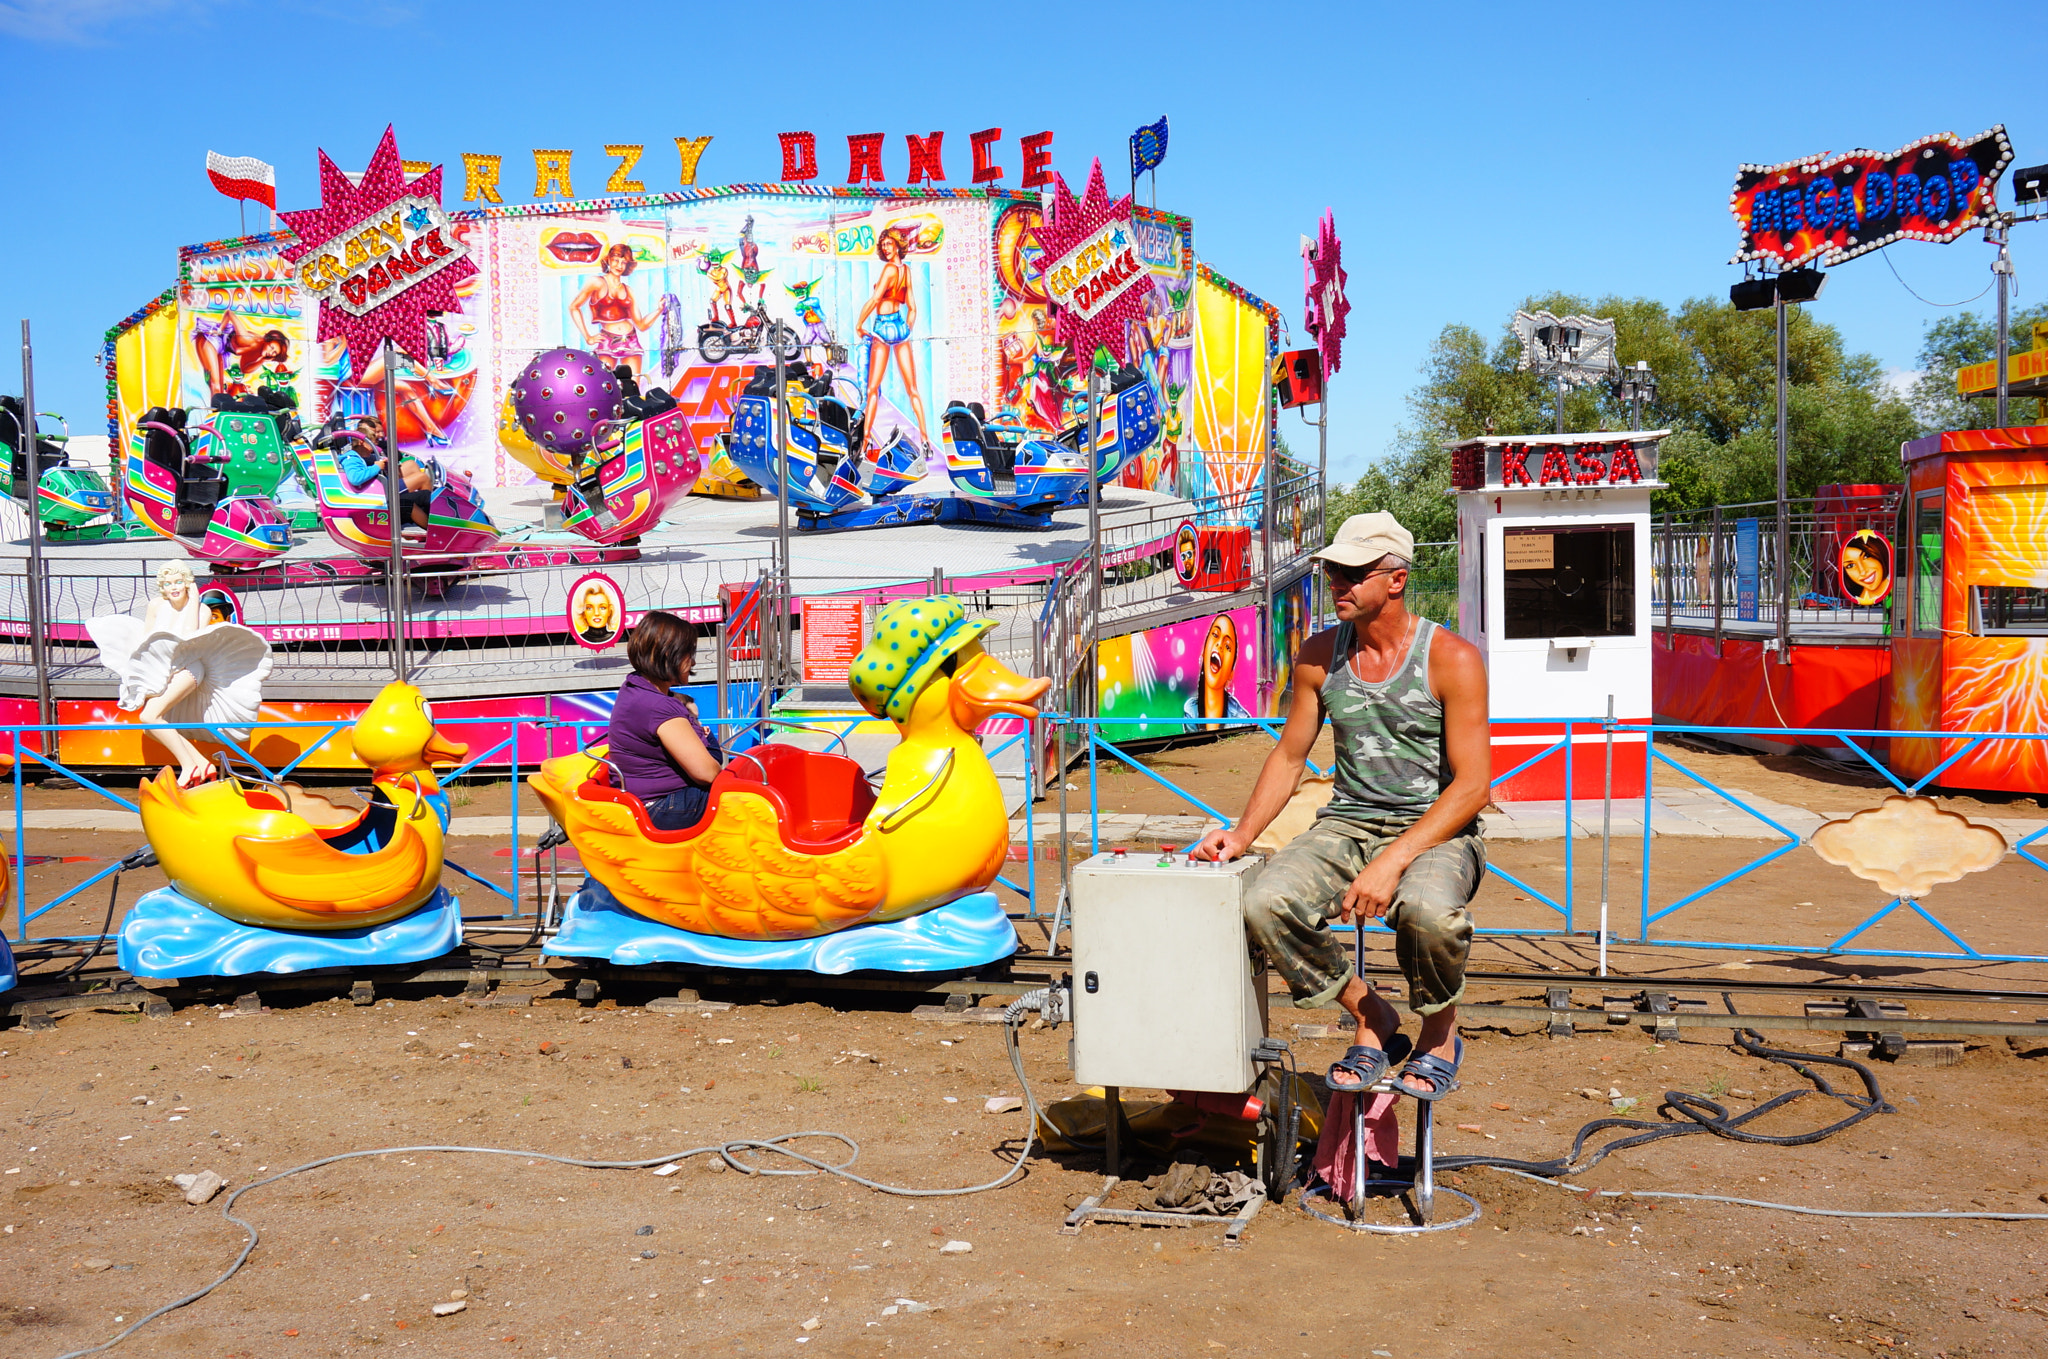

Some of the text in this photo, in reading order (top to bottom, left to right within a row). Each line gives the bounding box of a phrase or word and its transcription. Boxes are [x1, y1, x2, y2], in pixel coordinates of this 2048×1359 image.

[400, 128, 1055, 203] RAZY DANCE
[1751, 157, 1980, 233] MEGA DROP
[792, 234, 829, 253] DANCING
[837, 225, 875, 252] BAR
[302, 211, 405, 292] CRAZY
[672, 239, 698, 259] MUSIC
[340, 226, 454, 307] DANCE
[1050, 232, 1111, 296] CRAZY
[1073, 247, 1142, 312] DANCE
[207, 285, 302, 317] DANCE
[1961, 363, 1997, 390] MEG
[241, 433, 258, 445] 16
[665, 434, 680, 450] 11
[804, 466, 813, 477] 6
[1501, 443, 1643, 487] KASA
[977, 471, 986, 483] 7
[161, 507, 173, 520] 9
[607, 496, 625, 511] 11
[1494, 496, 1502, 514] 1
[366, 511, 389, 525] 12
[272, 627, 320, 640] STOP
